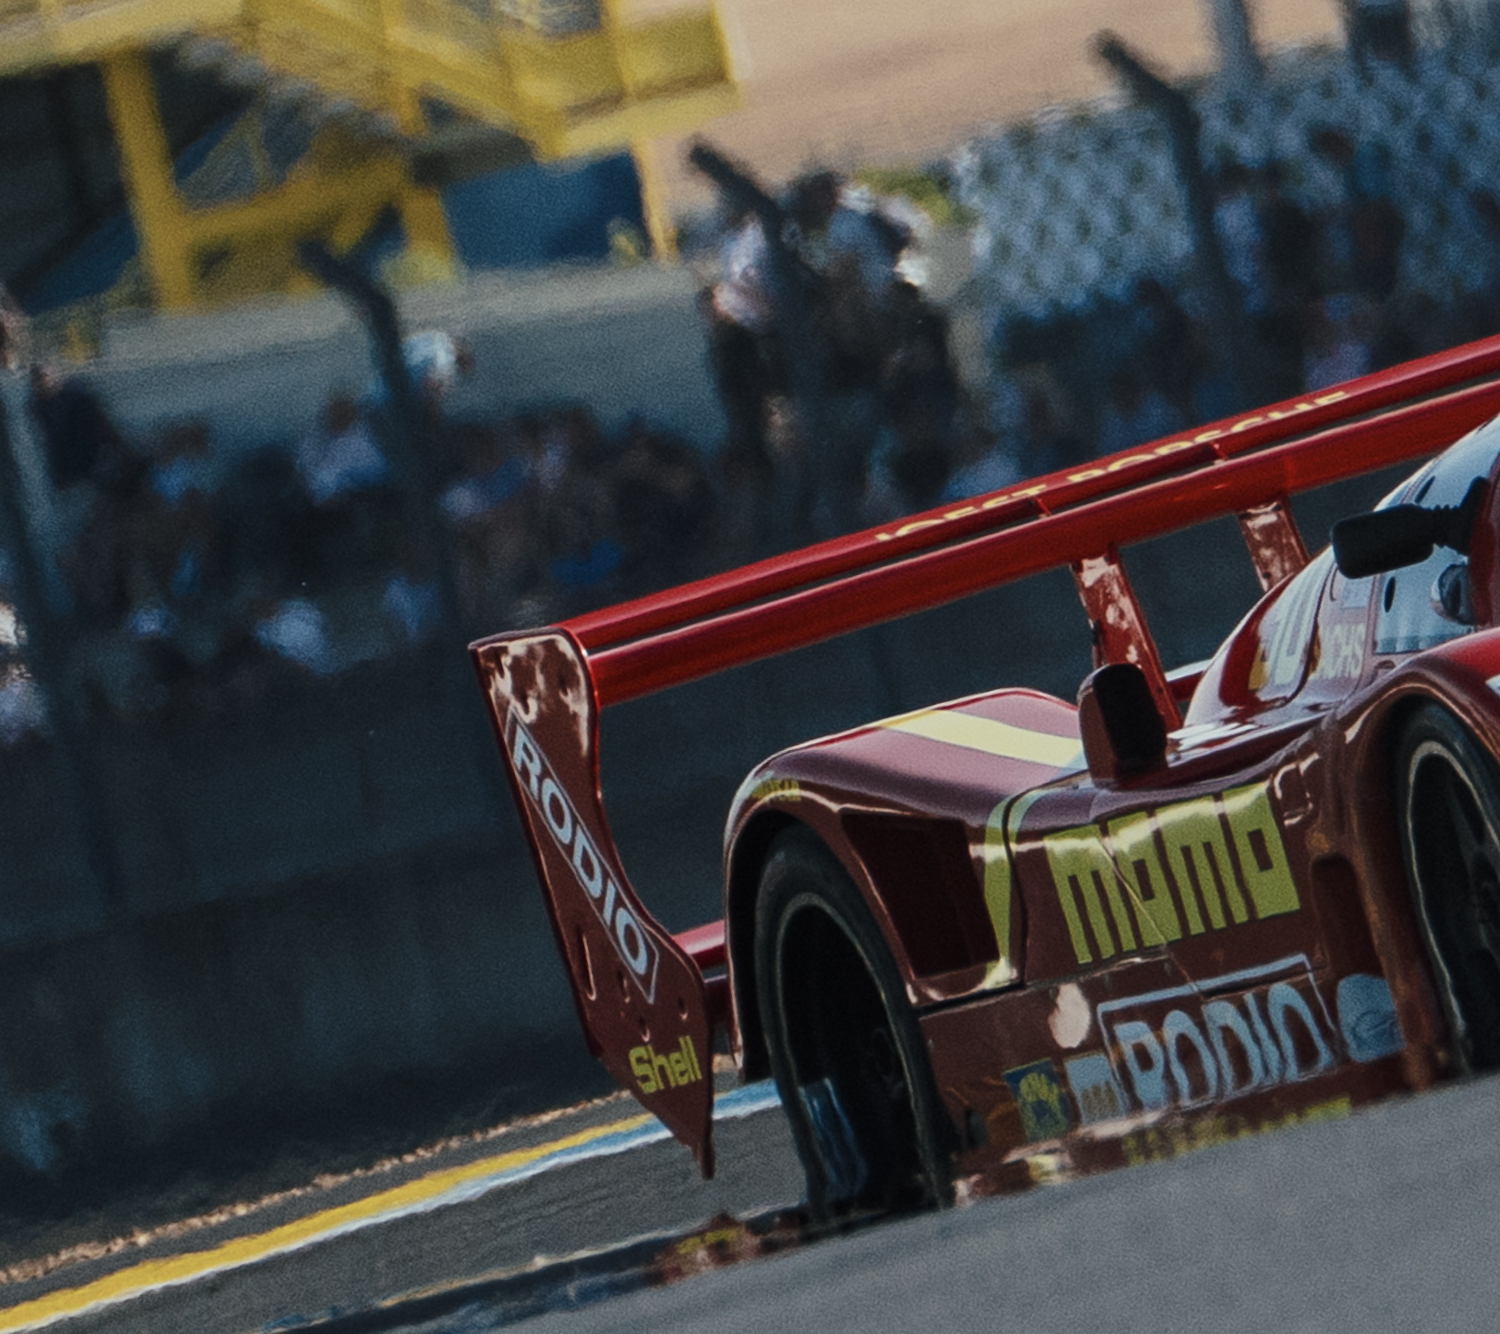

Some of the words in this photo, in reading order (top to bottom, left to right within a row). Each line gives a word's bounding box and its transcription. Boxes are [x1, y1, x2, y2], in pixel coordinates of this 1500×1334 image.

[514, 724, 648, 975] RODIO
[1044, 781, 1300, 964] momo
[629, 1035, 702, 1094] Shell
